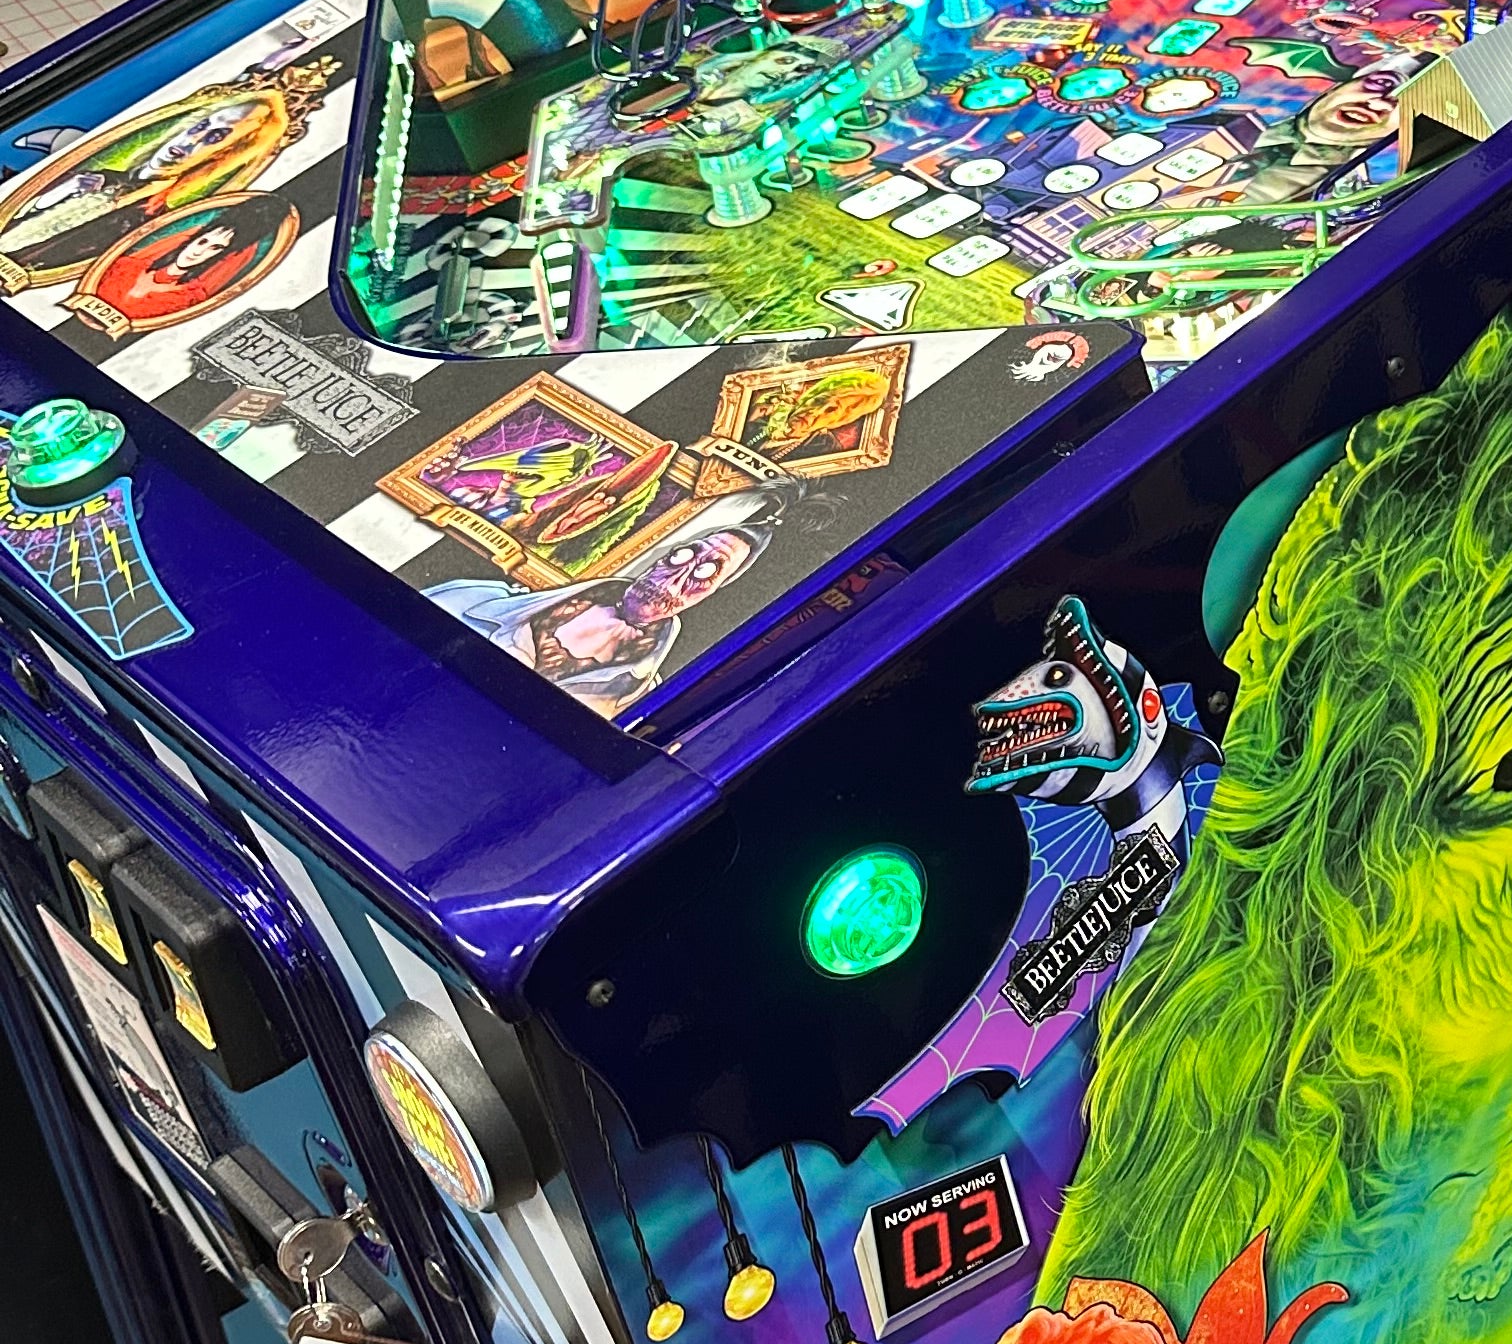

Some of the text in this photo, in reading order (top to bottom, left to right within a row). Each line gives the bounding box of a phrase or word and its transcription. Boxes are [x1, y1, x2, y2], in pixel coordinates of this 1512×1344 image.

[84, 299, 123, 325] LYDIA
[715, 444, 780, 480] JUNO
[449, 510, 472, 525] THE
[1024, 853, 1158, 995] BEETLEJUICE
[883, 1171, 997, 1230] NOW SERVING
[901, 1188, 1003, 1291] 03
